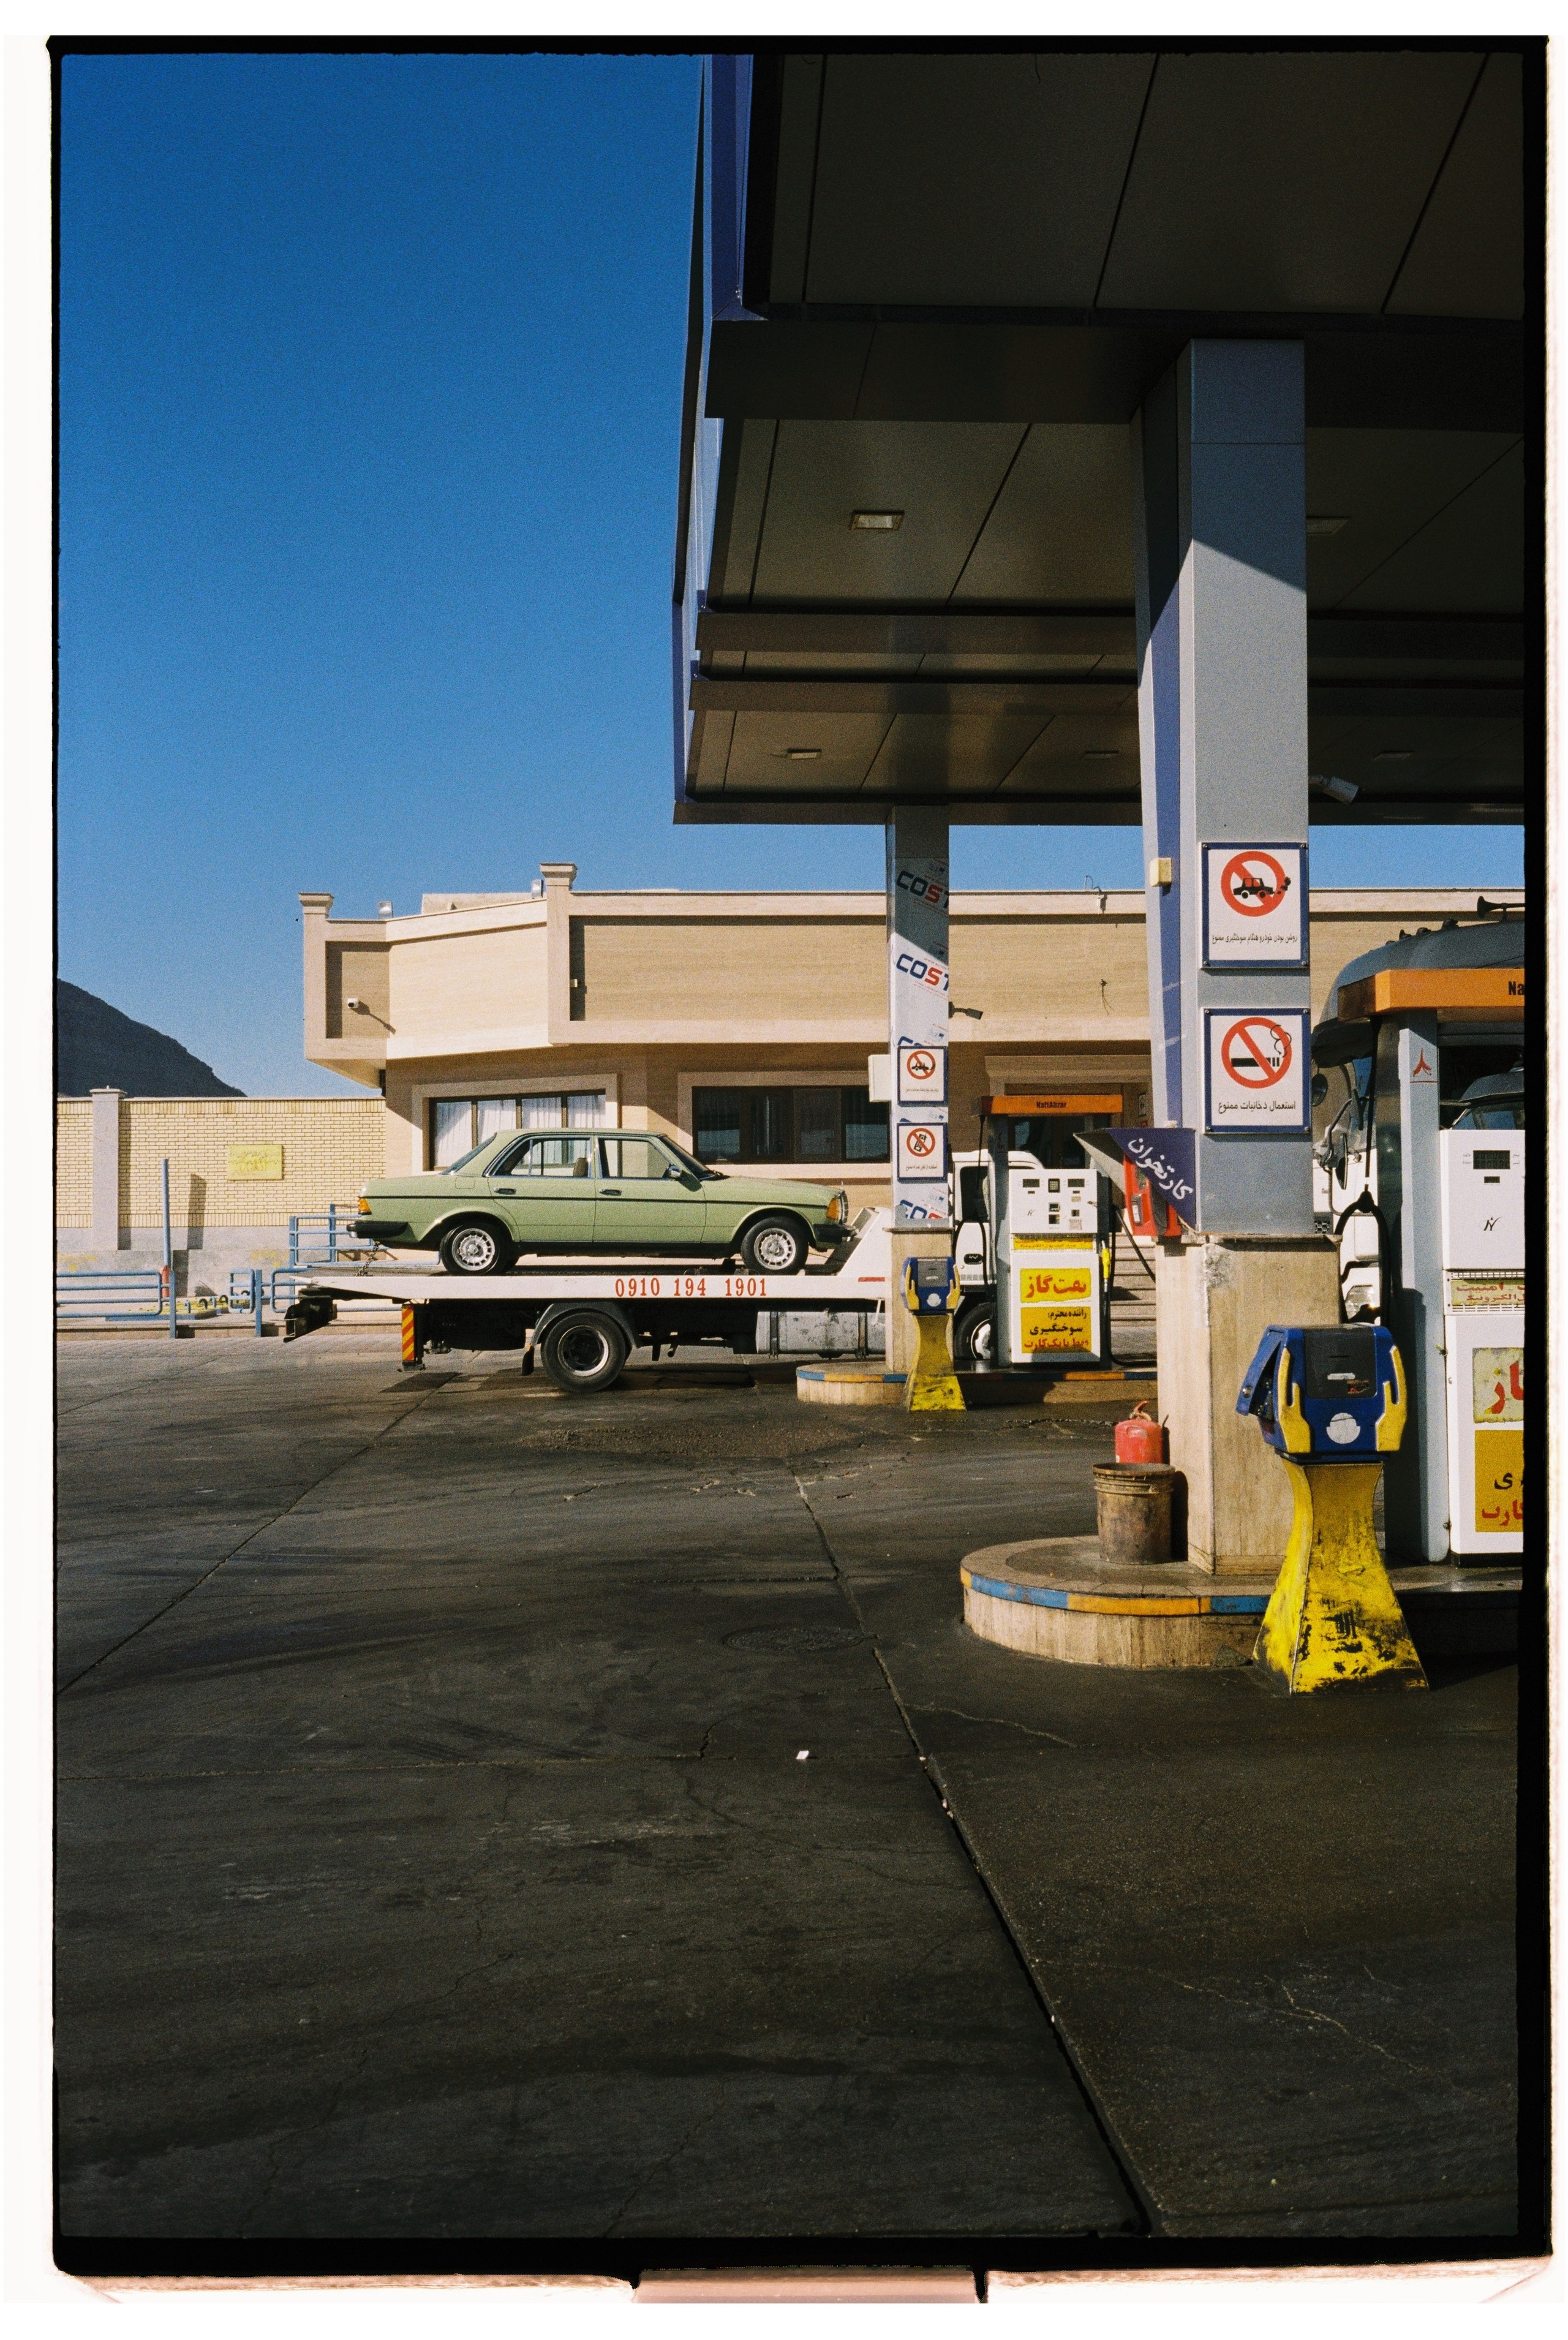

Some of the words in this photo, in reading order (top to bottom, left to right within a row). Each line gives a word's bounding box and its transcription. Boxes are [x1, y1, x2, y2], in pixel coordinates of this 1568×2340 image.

[1212, 934, 1224, 945] ممنوع
[1274, 934, 1284, 944] بودن
[1285, 934, 1298, 944] روشن
[1218, 1101, 1238, 1114] ممنوع
[1240, 1100, 1268, 1112] دخانیات
[1269, 1100, 1296, 1112] استعمال
[1128, 1138, 1194, 1200] کارتخوان
[615, 1277, 660, 1297] 0910
[674, 1277, 706, 1297] 194
[725, 1278, 767, 1297] 1901
